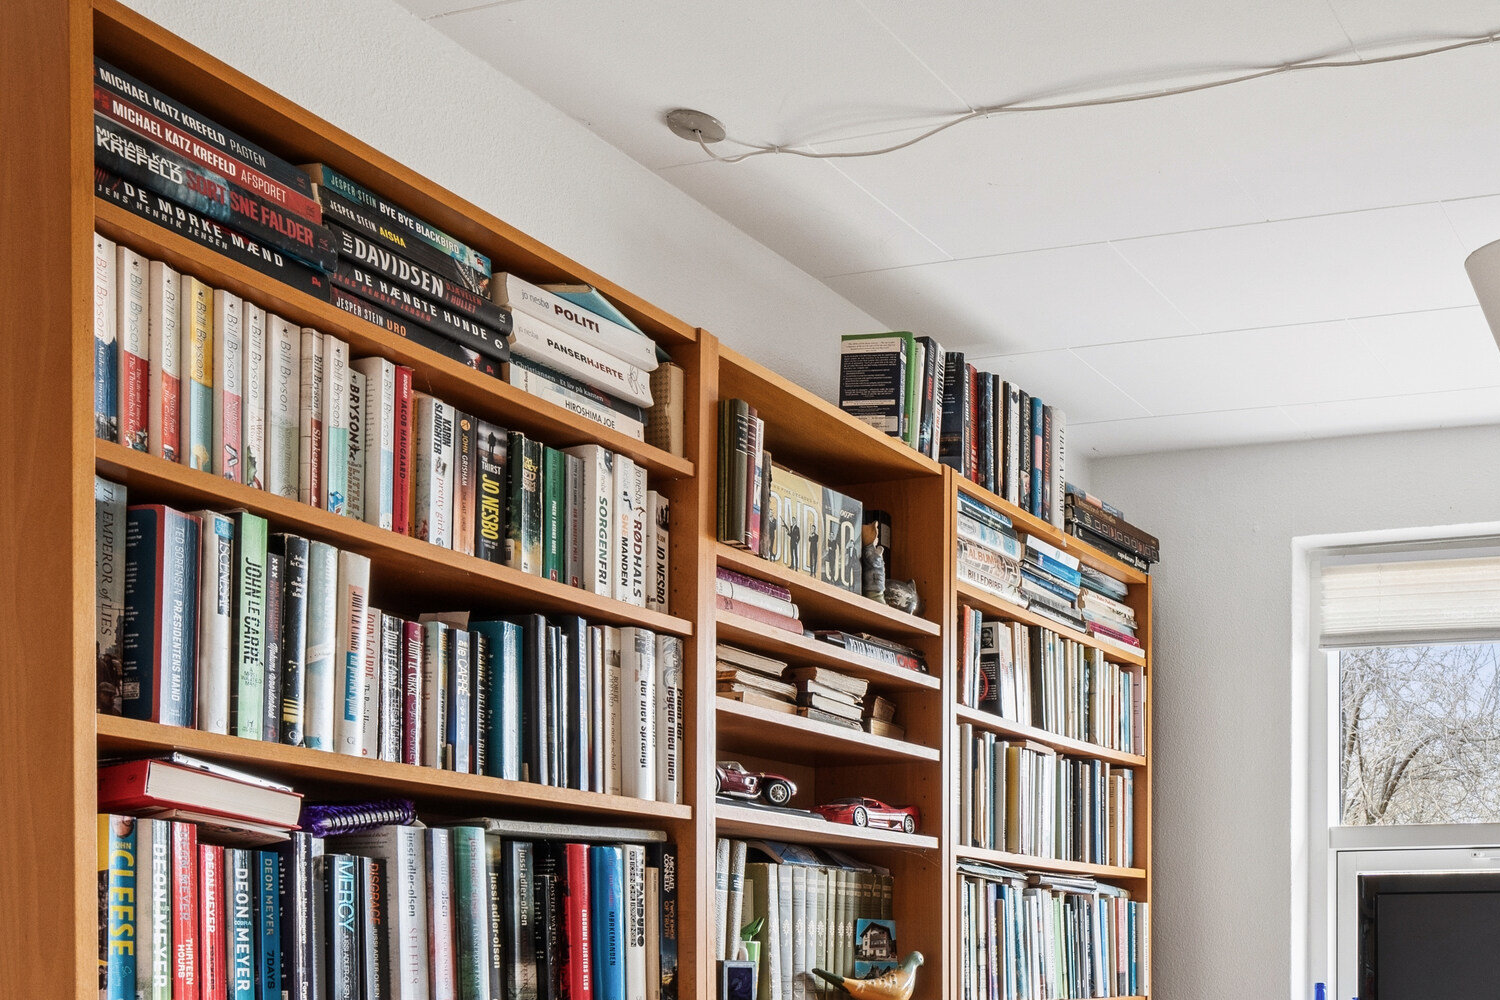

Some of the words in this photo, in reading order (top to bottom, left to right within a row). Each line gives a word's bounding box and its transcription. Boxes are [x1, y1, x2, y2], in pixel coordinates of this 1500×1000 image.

[99, 67, 151, 106] MICHAEL
[153, 97, 180, 121] KATZ
[182, 114, 225, 146] KREFELD
[230, 138, 266, 168] PAGTEN
[95, 125, 149, 156] MICHAEL
[152, 153, 181, 173] KATZ
[112, 100, 162, 139] MICHAEL
[165, 128, 191, 153] KATZ
[193, 143, 236, 177] KREFELD
[241, 170, 286, 203] AFSPORET
[96, 134, 182, 185] KREFELD
[186, 169, 226, 205] SORT
[230, 192, 257, 220] SNE
[261, 205, 313, 247] FALDER
[331, 175, 356, 195] JESPER
[358, 190, 377, 208] STEIN
[379, 203, 397, 219] BYE
[398, 212, 414, 229] BYE
[416, 222, 459, 253] BLACKBIRD
[124, 181, 148, 203] DE
[158, 198, 223, 238] MØRKE
[232, 235, 283, 267] MÆND
[330, 200, 355, 220] JESPER
[357, 214, 377, 232] STEIN
[379, 227, 406, 248] AISHA
[130, 273, 142, 301] Bill
[343, 231, 353, 254] LEIF
[355, 238, 444, 297] DAVIDSEN
[127, 303, 142, 352] Bryson
[227, 314, 237, 339] Bill
[337, 297, 362, 317] JESPER
[364, 308, 383, 326] STEIN
[387, 319, 407, 337] URO
[355, 270, 372, 287] DE
[380, 281, 437, 317] HÆNGTE
[444, 311, 487, 340] HUNDE
[554, 304, 600, 334] POLITI
[226, 340, 237, 388] Bryson
[546, 338, 624, 381] PANSERHJERTE
[313, 376, 321, 409] Bryson
[565, 400, 602, 424] HIROSHIMA
[603, 417, 616, 429] JOE
[433, 403, 443, 454] SLAUGHTER
[442, 418, 451, 447] KARIN
[312, 428, 320, 489] Shakespeare
[399, 429, 407, 479] HAUGAARD
[1059, 463, 1064, 472] A
[103, 487, 114, 506] The
[436, 477, 445, 509] pretty
[482, 474, 499, 493] JO
[175, 527, 184, 543] TED
[435, 512, 446, 535] girls
[481, 494, 499, 539] NESBO
[599, 496, 608, 585] SORGENFRI
[101, 511, 114, 583] EMPEROR
[174, 545, 184, 595] SORENSEN
[633, 520, 642, 597] RØDHALS
[99, 588, 113, 601] of
[245, 557, 262, 599] JOHN
[101, 602, 113, 637] LIES
[248, 600, 259, 613] LE
[172, 600, 182, 671] PRÆSIDENTENS
[243, 615, 263, 665] CARRÉ
[171, 673, 181, 701] MAND
[180, 831, 189, 870] DEON
[406, 833, 415, 856] jussi
[180, 874, 190, 920] MEYER
[236, 868, 248, 918] DEON
[265, 859, 273, 890] DEON
[338, 860, 354, 933] MERCY
[407, 858, 416, 917] adler-olsen
[110, 850, 134, 956] CLEESE
[266, 895, 274, 936] MEYER
[237, 928, 250, 991] MEYER
[409, 928, 417, 984] SELFIES
